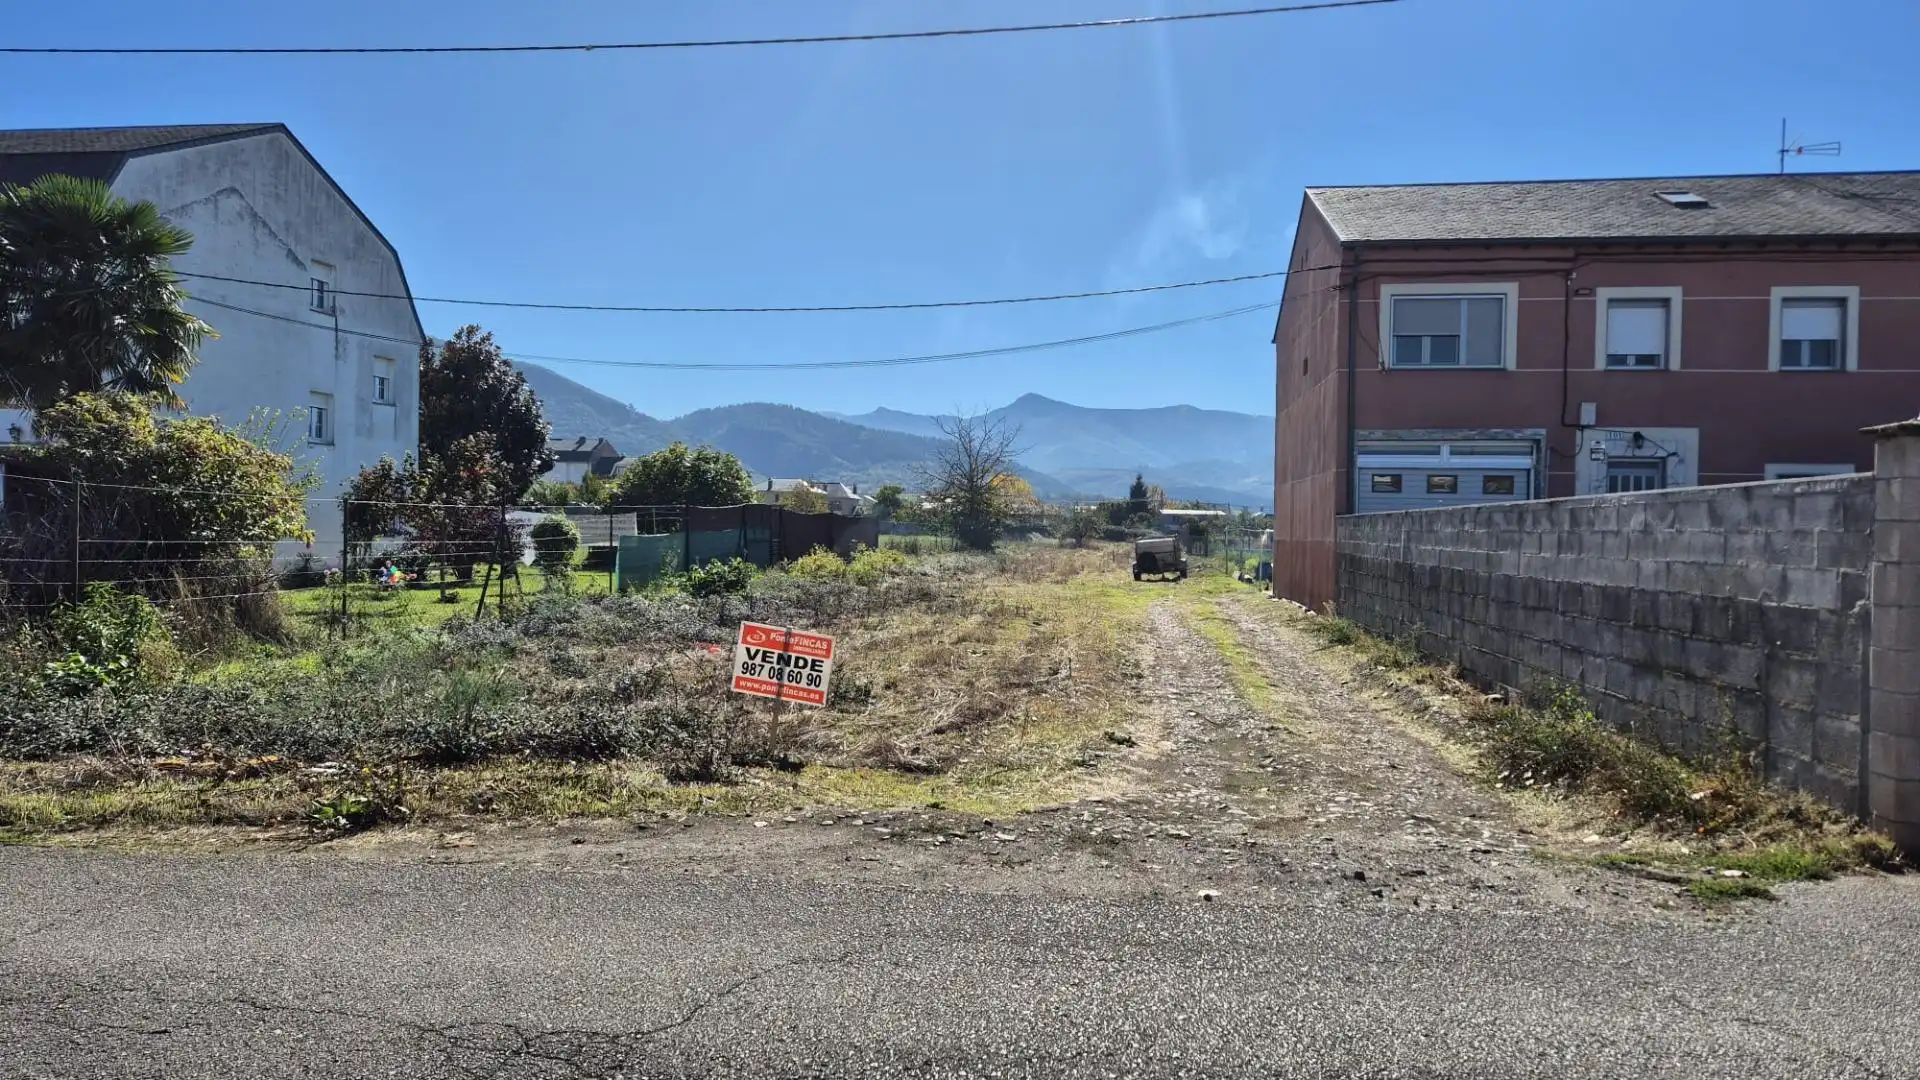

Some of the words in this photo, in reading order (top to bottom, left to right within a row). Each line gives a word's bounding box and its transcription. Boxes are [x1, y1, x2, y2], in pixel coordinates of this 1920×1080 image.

[745, 647, 824, 673] VENDE
[741, 661, 765, 677] 987
[768, 666, 784, 681] 08
[787, 669, 803, 685] 60
[806, 673, 822, 688] 90
